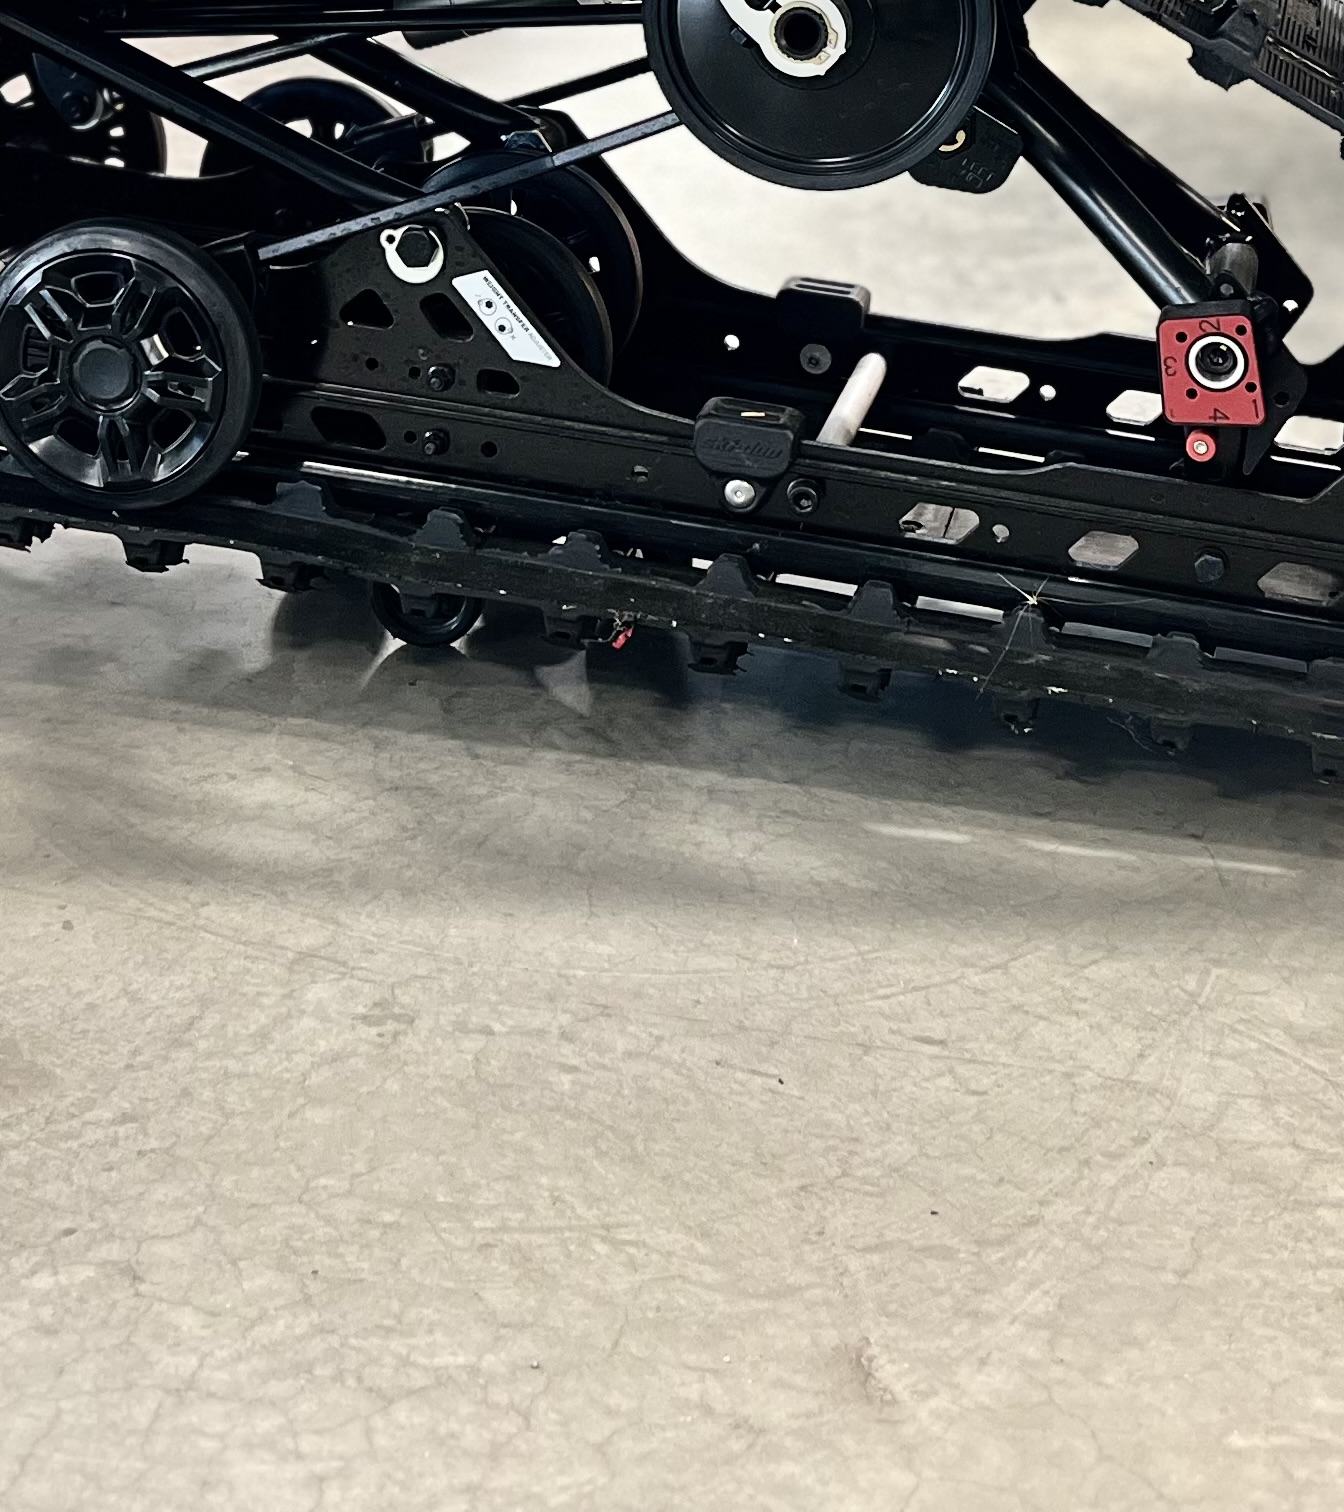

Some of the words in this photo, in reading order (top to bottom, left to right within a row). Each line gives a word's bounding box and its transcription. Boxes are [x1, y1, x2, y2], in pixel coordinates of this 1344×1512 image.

[502, 299, 530, 333] TRANSFER
[1198, 318, 1222, 333] 2
[1163, 355, 1178, 377] 3
[1208, 408, 1231, 422] 4
